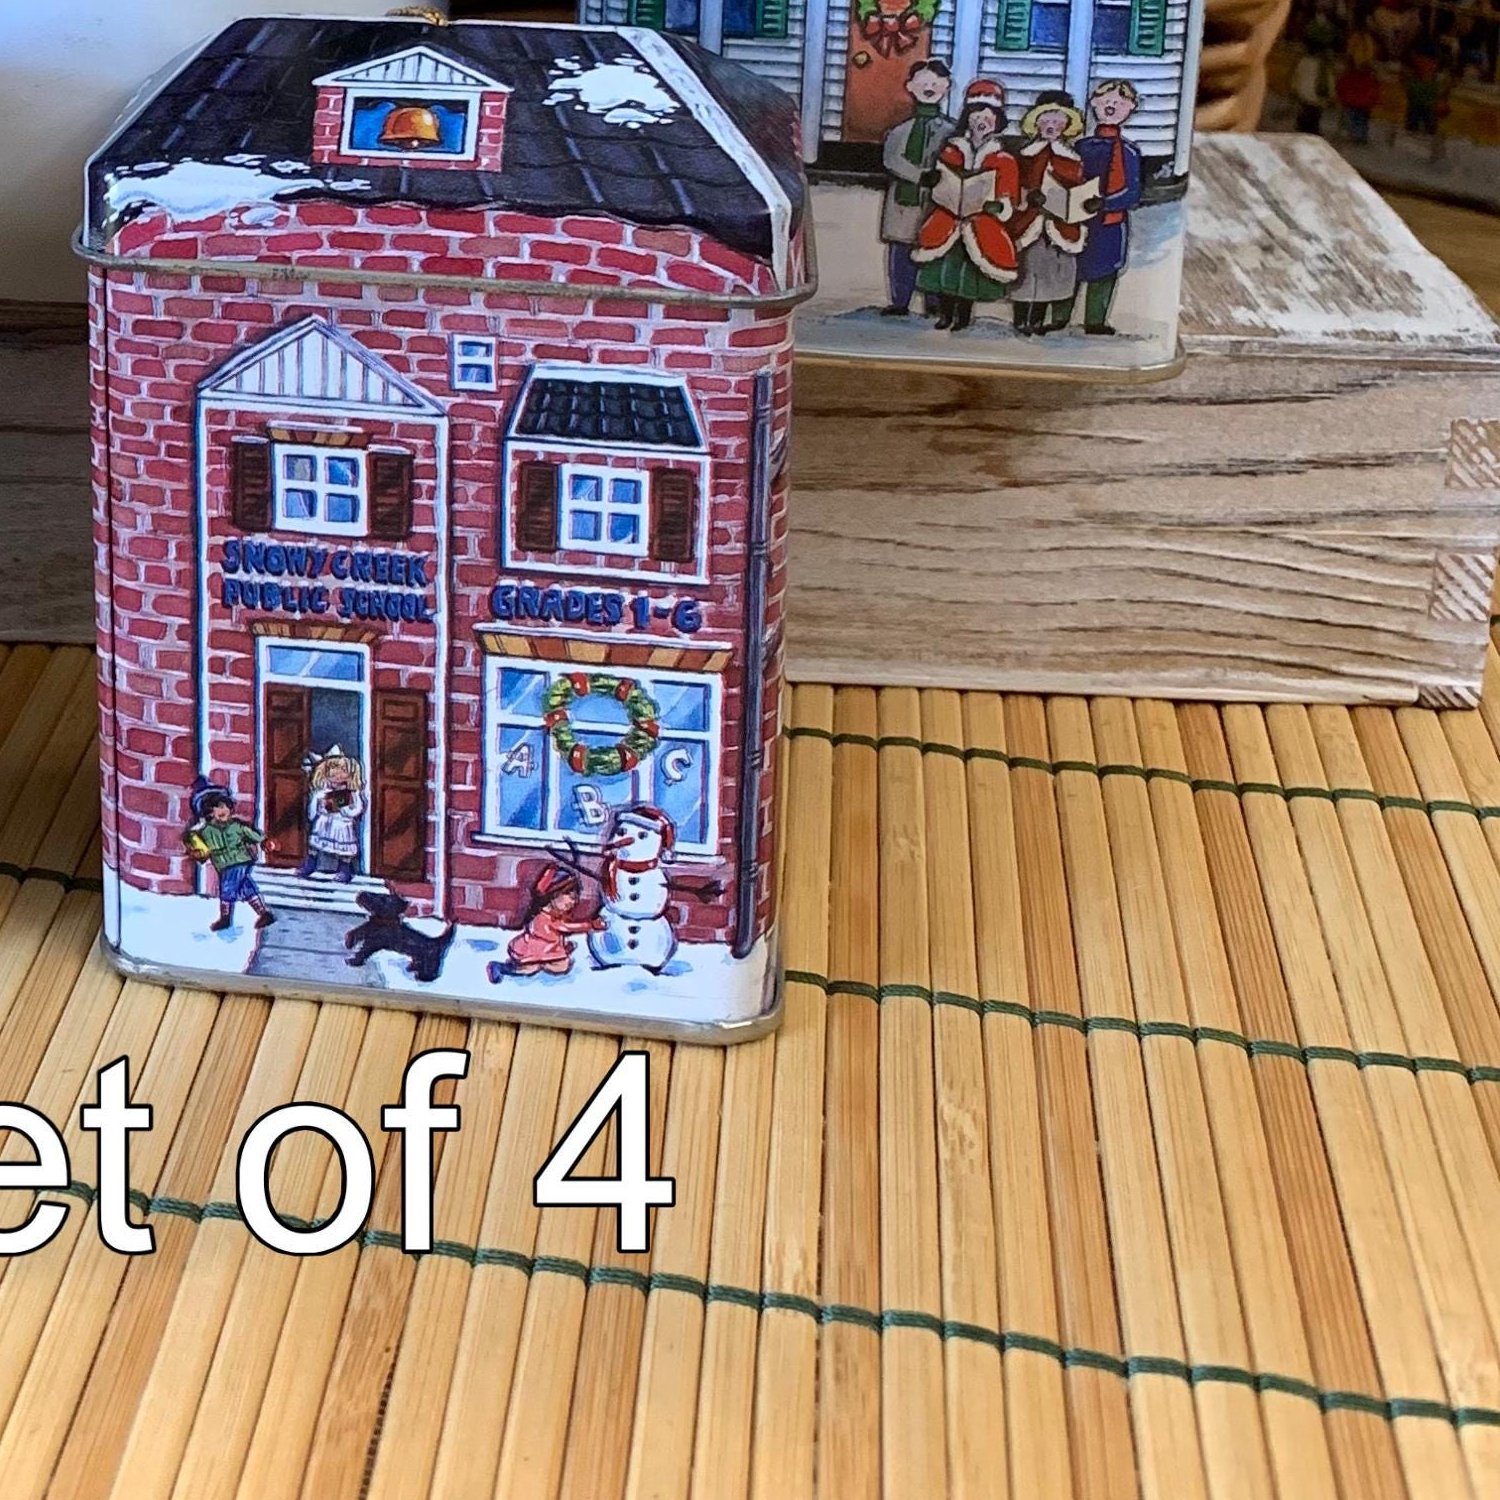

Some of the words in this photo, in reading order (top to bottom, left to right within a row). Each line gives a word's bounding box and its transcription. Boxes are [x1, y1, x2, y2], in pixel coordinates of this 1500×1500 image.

[221, 536, 328, 579] SNOWY
[331, 549, 429, 588] CREEK
[221, 577, 330, 614] PUBLIC
[336, 586, 436, 623] SCHOOL
[489, 583, 625, 627] GRADES
